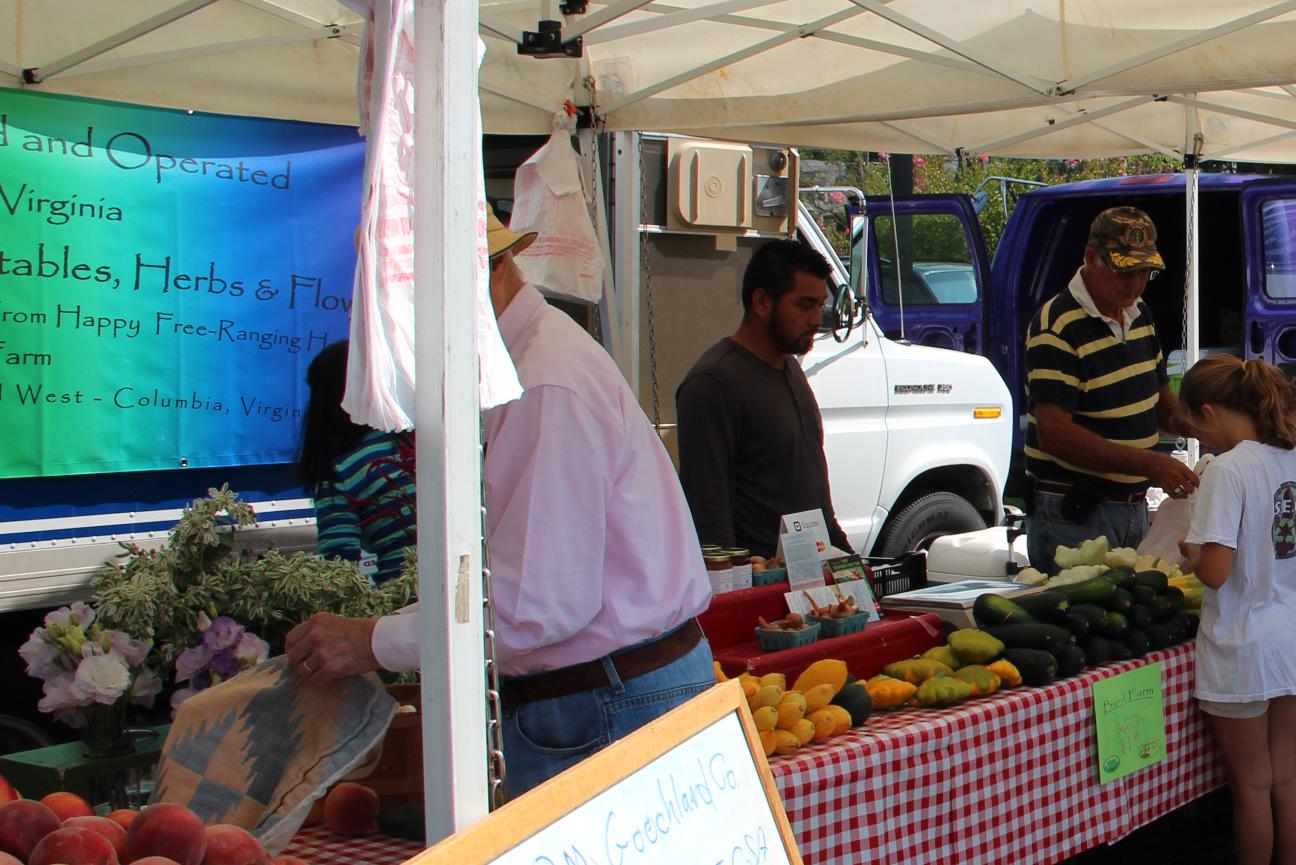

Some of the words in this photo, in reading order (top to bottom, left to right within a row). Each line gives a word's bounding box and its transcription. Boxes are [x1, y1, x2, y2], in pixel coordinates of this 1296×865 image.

[22, 127, 94, 158] and
[106, 132, 291, 190] Operated
[0, 183, 122, 225] Virginia
[0, 243, 120, 289] tables,
[134, 253, 244, 293] Herbs
[254, 279, 280, 300] &
[56, 304, 140, 338] Happy
[155, 312, 301, 353] Free-Ranging
[16, 384, 83, 406] West
[113, 387, 230, 414] Columbia,
[1127, 686, 1155, 703] Farm
